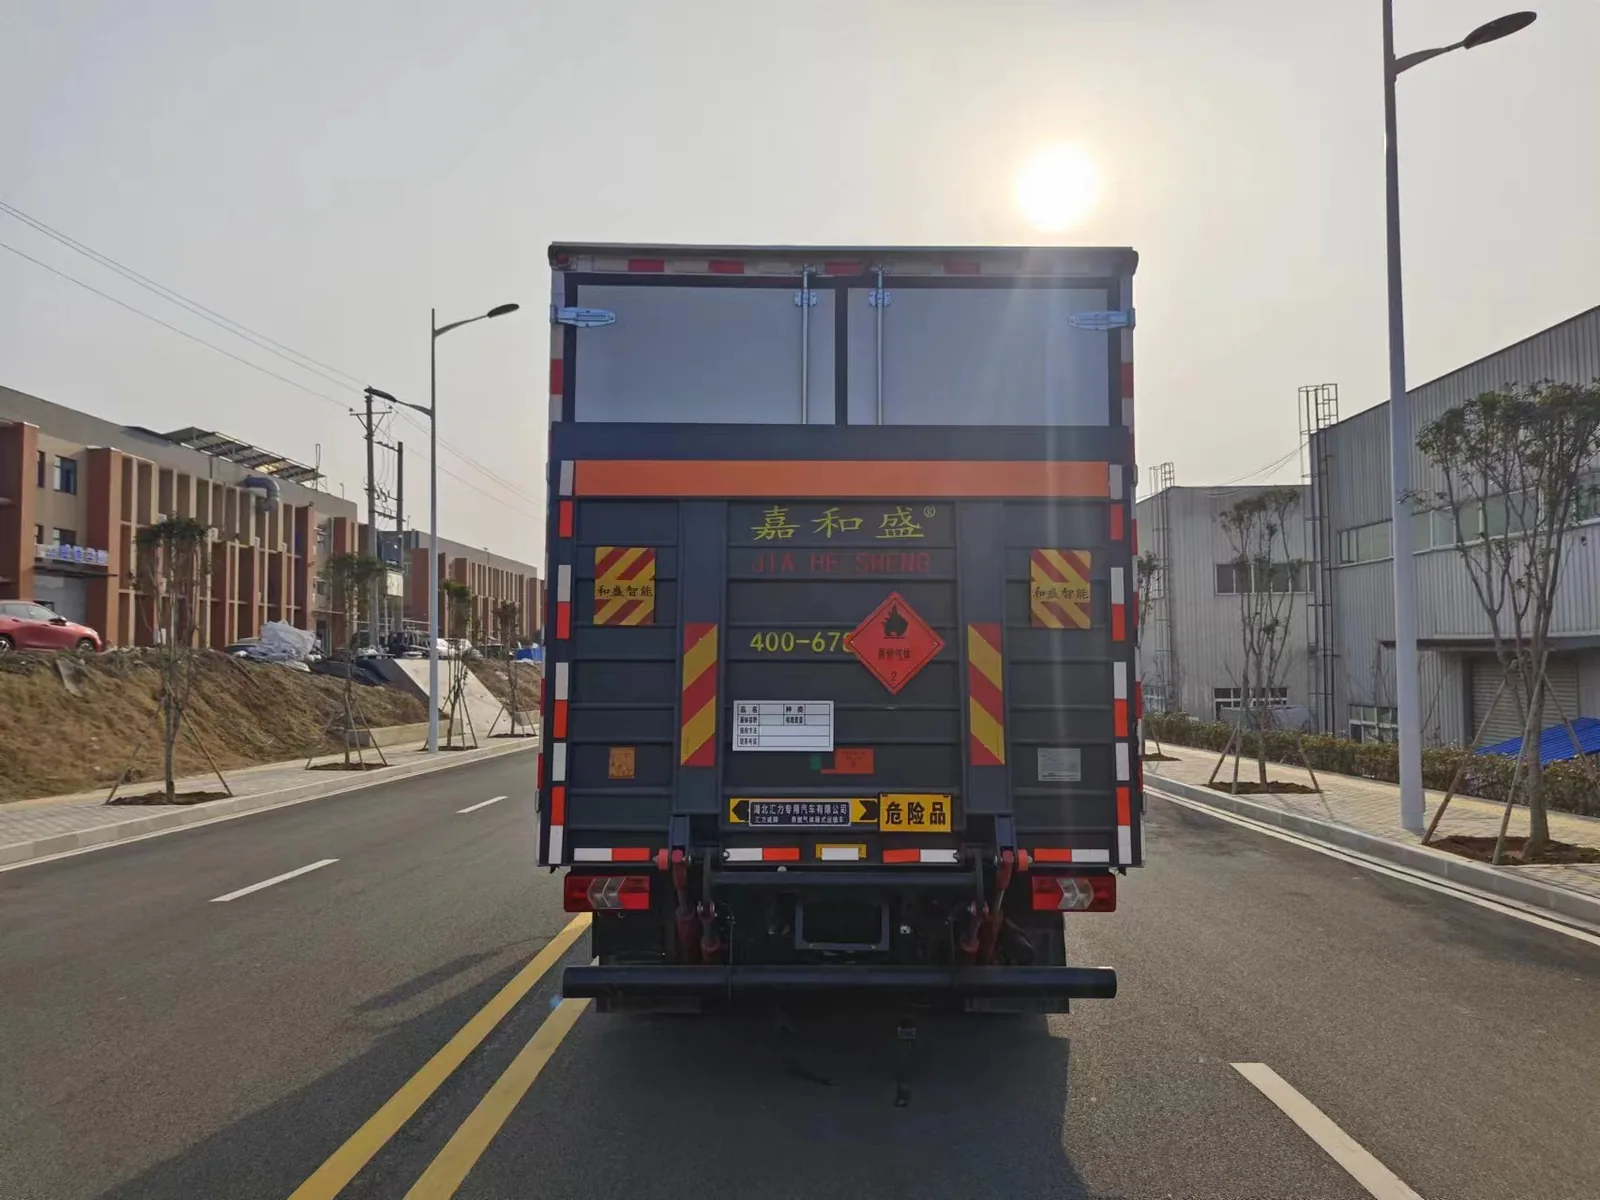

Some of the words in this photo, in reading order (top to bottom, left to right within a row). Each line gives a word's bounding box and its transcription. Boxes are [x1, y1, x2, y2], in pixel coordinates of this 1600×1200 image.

[752, 552, 795, 573] JIA
[810, 552, 840, 573] HE
[855, 552, 931, 573] SHENG
[596, 585, 654, 598] 和盛智能
[1032, 586, 1089, 600] 和盛智能
[891, 670, 898, 682] 2
[753, 804, 847, 815] 湖北汇力专用汽车有限公司
[885, 801, 947, 826] 危险品
